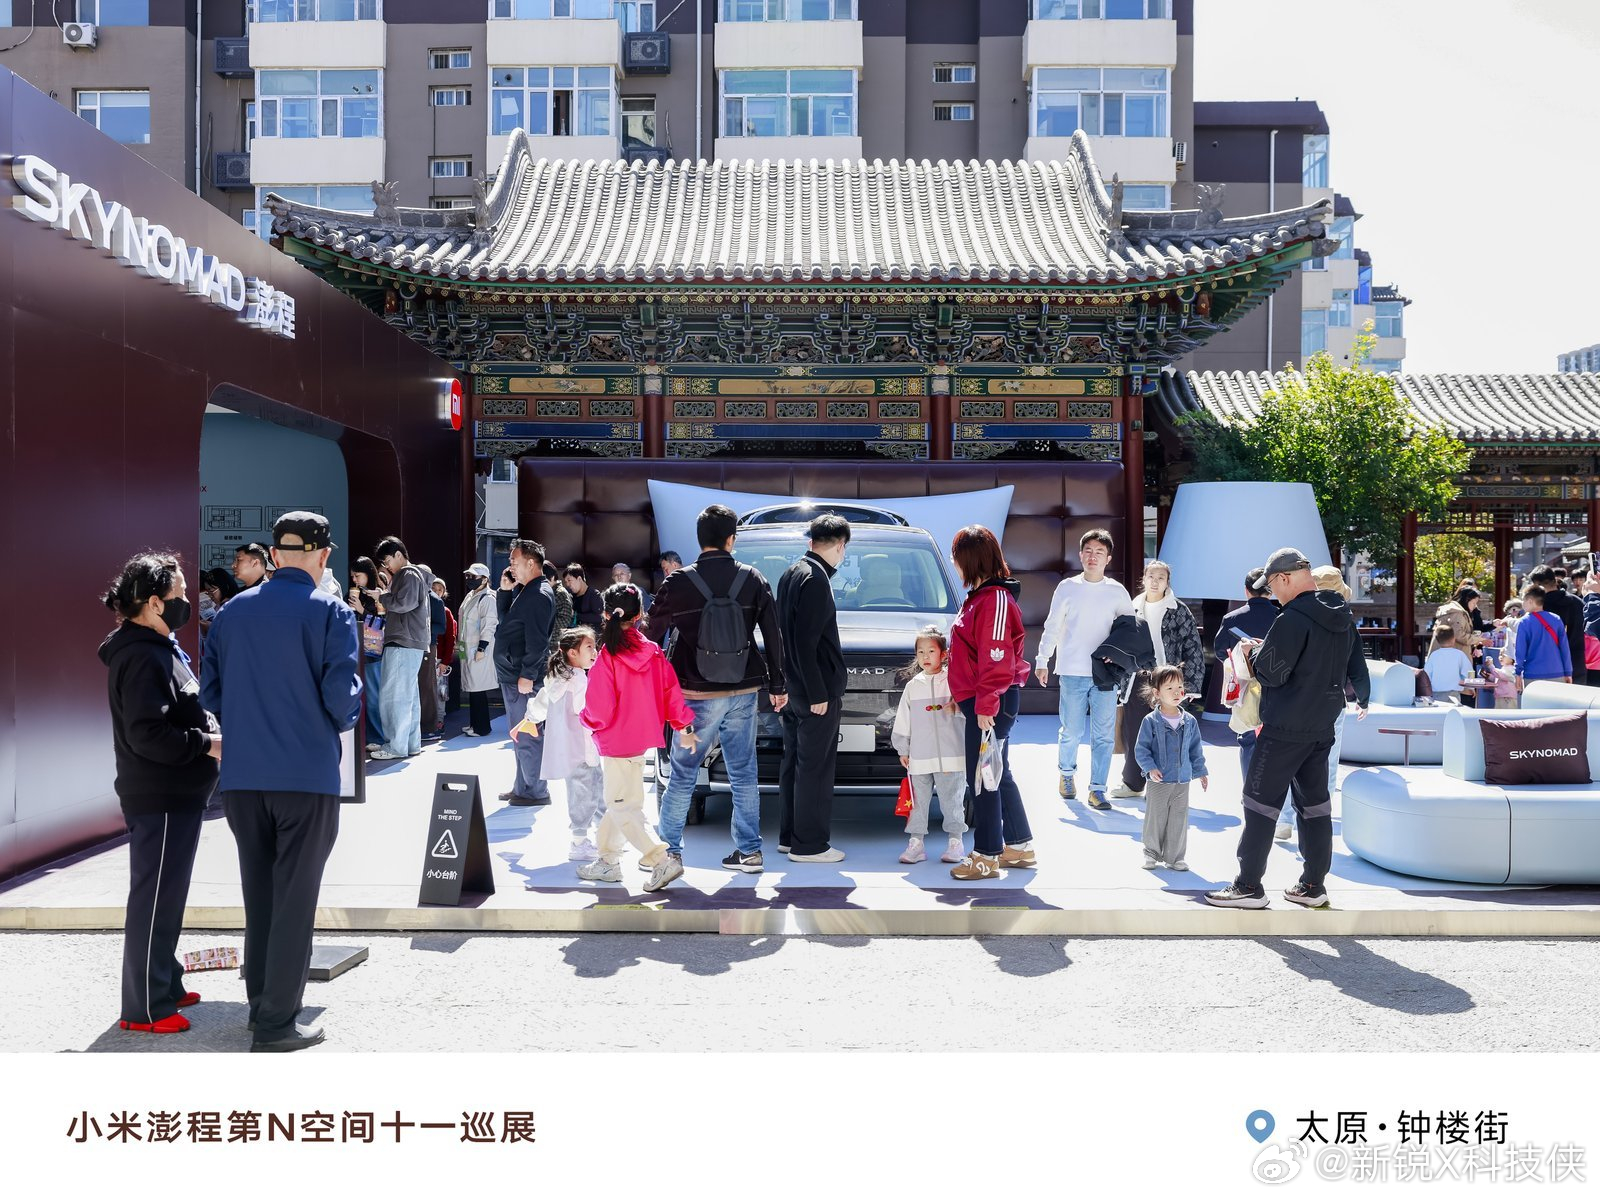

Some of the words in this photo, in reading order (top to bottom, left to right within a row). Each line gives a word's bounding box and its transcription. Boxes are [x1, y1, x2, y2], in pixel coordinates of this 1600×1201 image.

[13, 154, 246, 312] SKYNOMAD
[247, 276, 296, 340] 澎程
[1509, 747, 1578, 760] SKYNOMAD
[426, 868, 458, 880] 小心台阶
